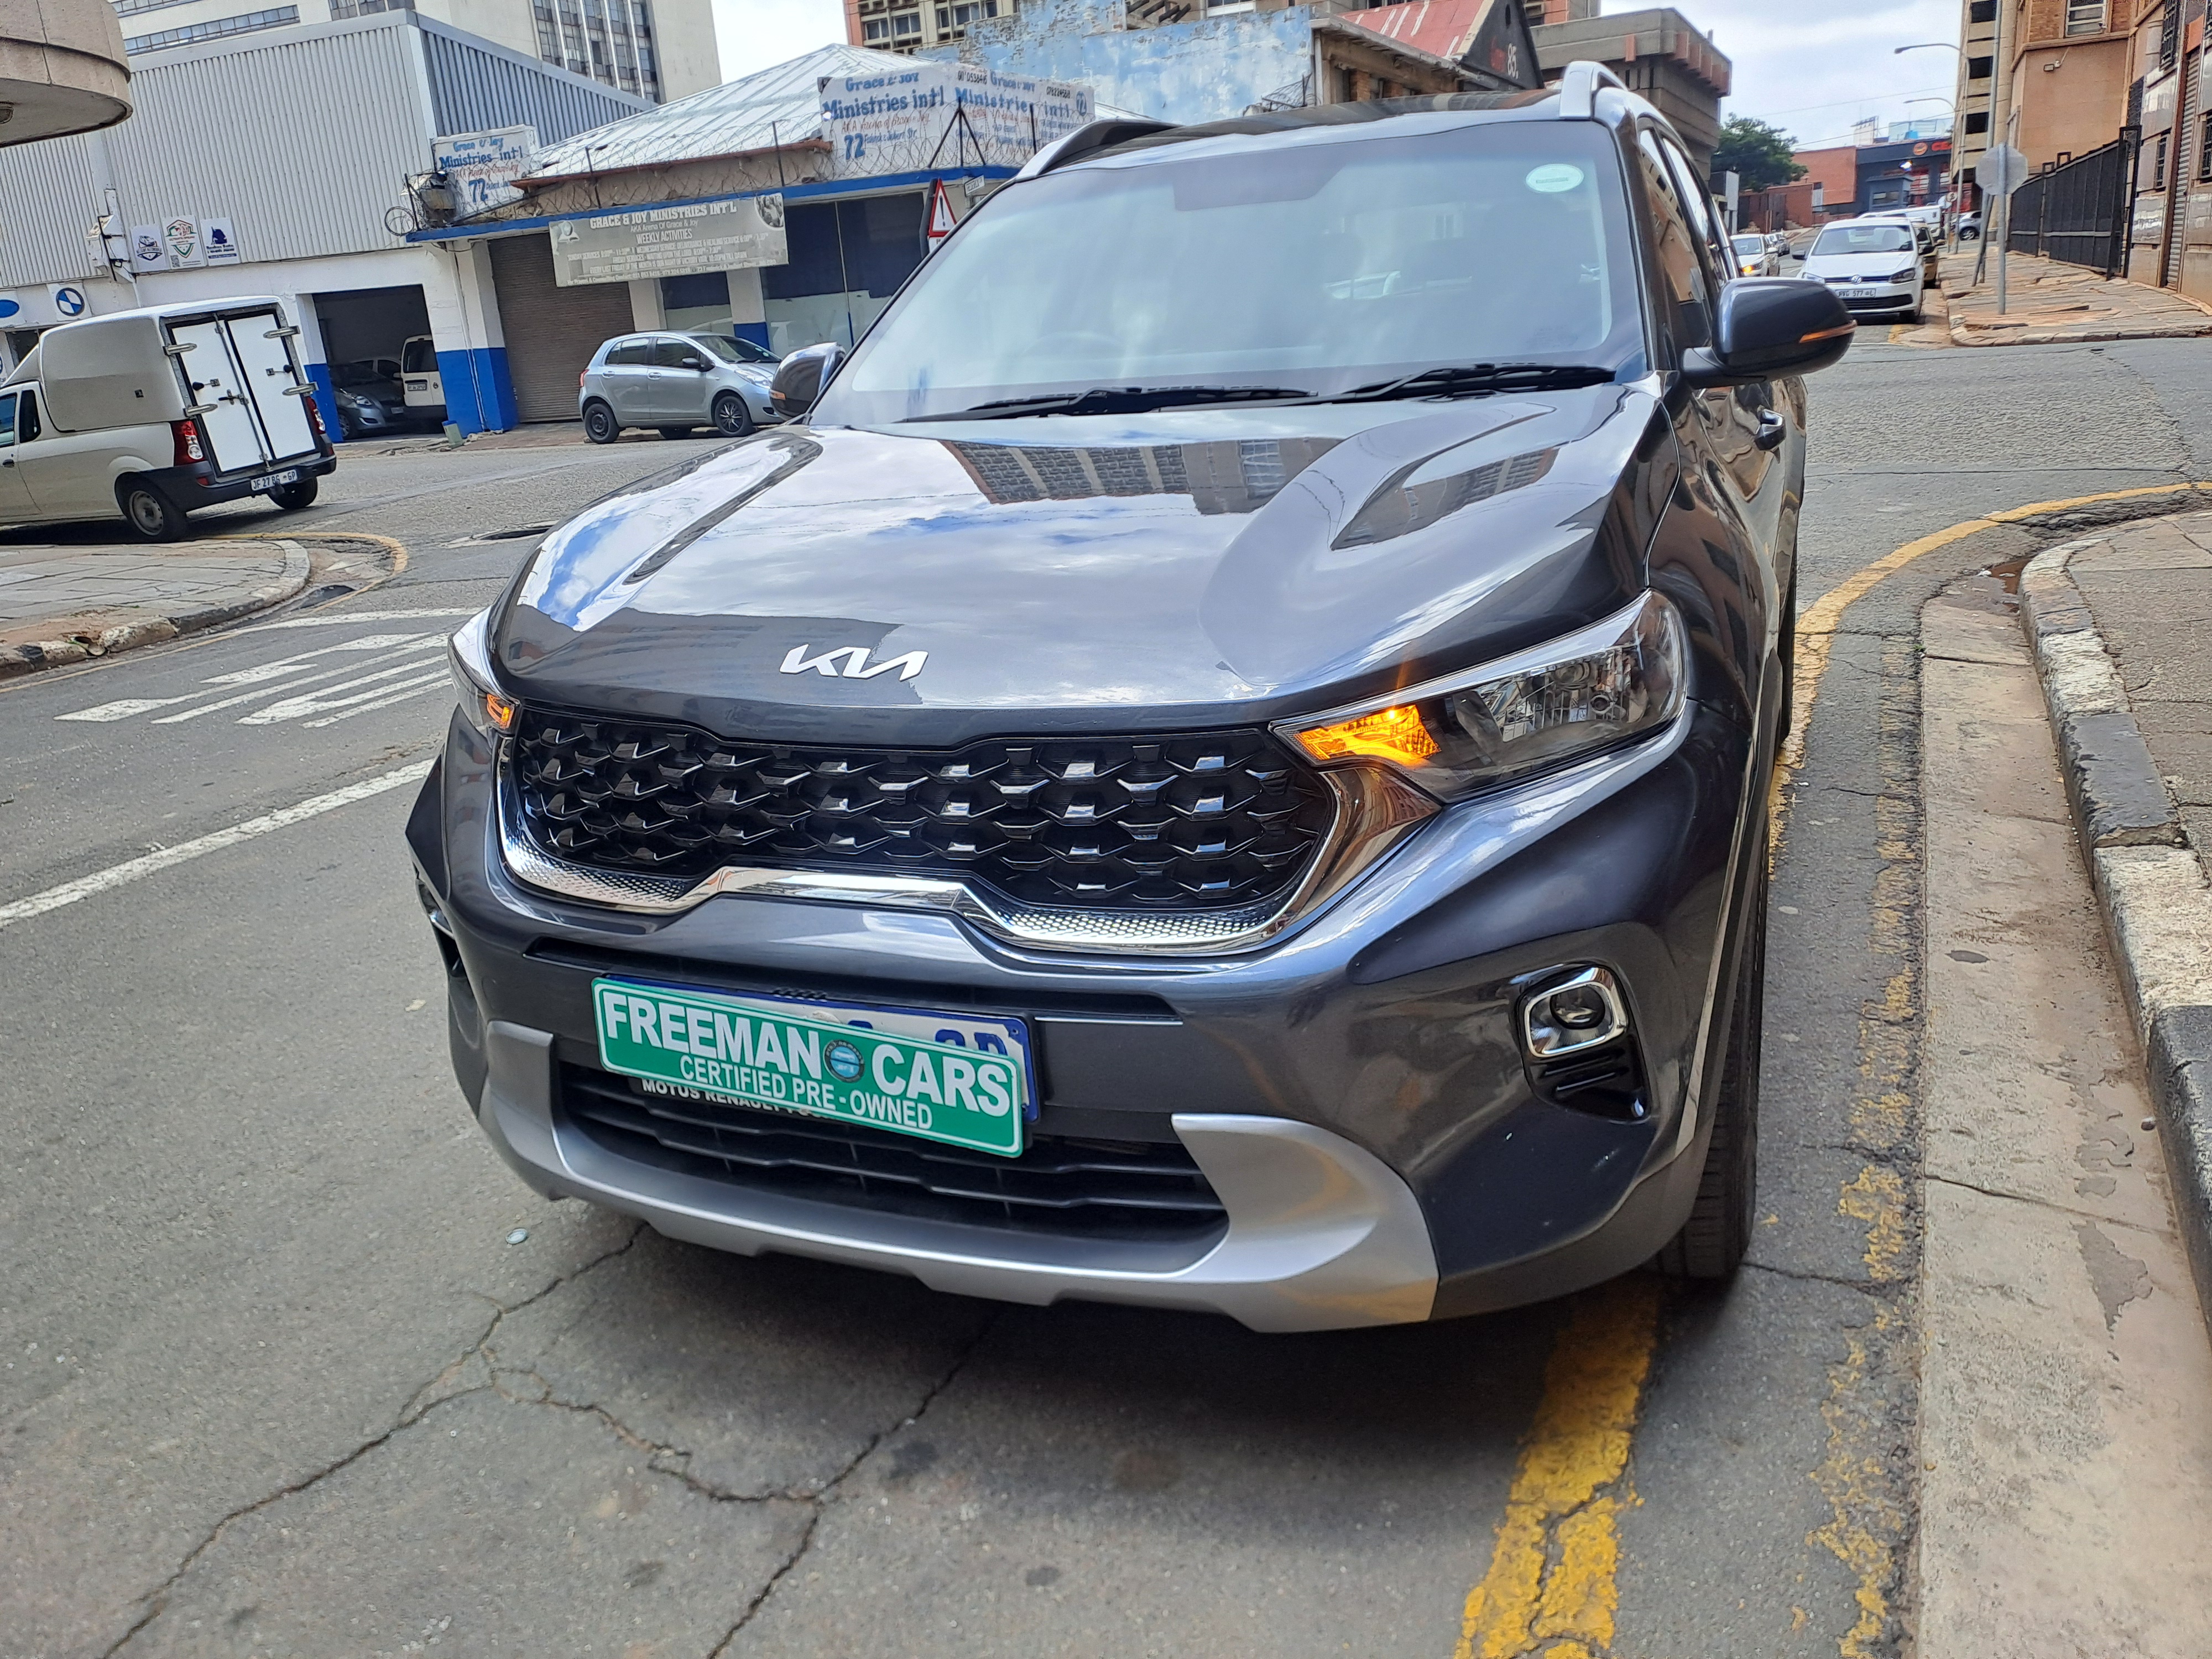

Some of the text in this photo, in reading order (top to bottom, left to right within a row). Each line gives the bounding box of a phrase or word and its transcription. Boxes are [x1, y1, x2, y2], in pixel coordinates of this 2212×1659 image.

[846, 77, 884, 91] Grace
[899, 72, 919, 83] JOY
[822, 93, 908, 120] Ministries
[955, 87, 1030, 113] Ministrie
[844, 133, 865, 160] 72
[439, 152, 492, 169] Ministries
[468, 178, 488, 204] 72
[589, 201, 737, 229] GRACE & JOY MINISTRIES INT'L
[690, 219, 698, 228] Joy
[637, 228, 692, 244] WEEKLY ACTIVITIES
[253, 479, 260, 489] JF
[263, 477, 270, 487] 27
[288, 472, 295, 481] GP
[780, 644, 928, 682] KIA
[603, 990, 822, 1080] FREEMAN
[872, 1044, 1010, 1117] CARS
[641, 1078, 701, 1100] MOTUS
[680, 1055, 786, 1099] CERTIFIED
[792, 1078, 836, 1111] PRE
[850, 1090, 932, 1130] OWNED
